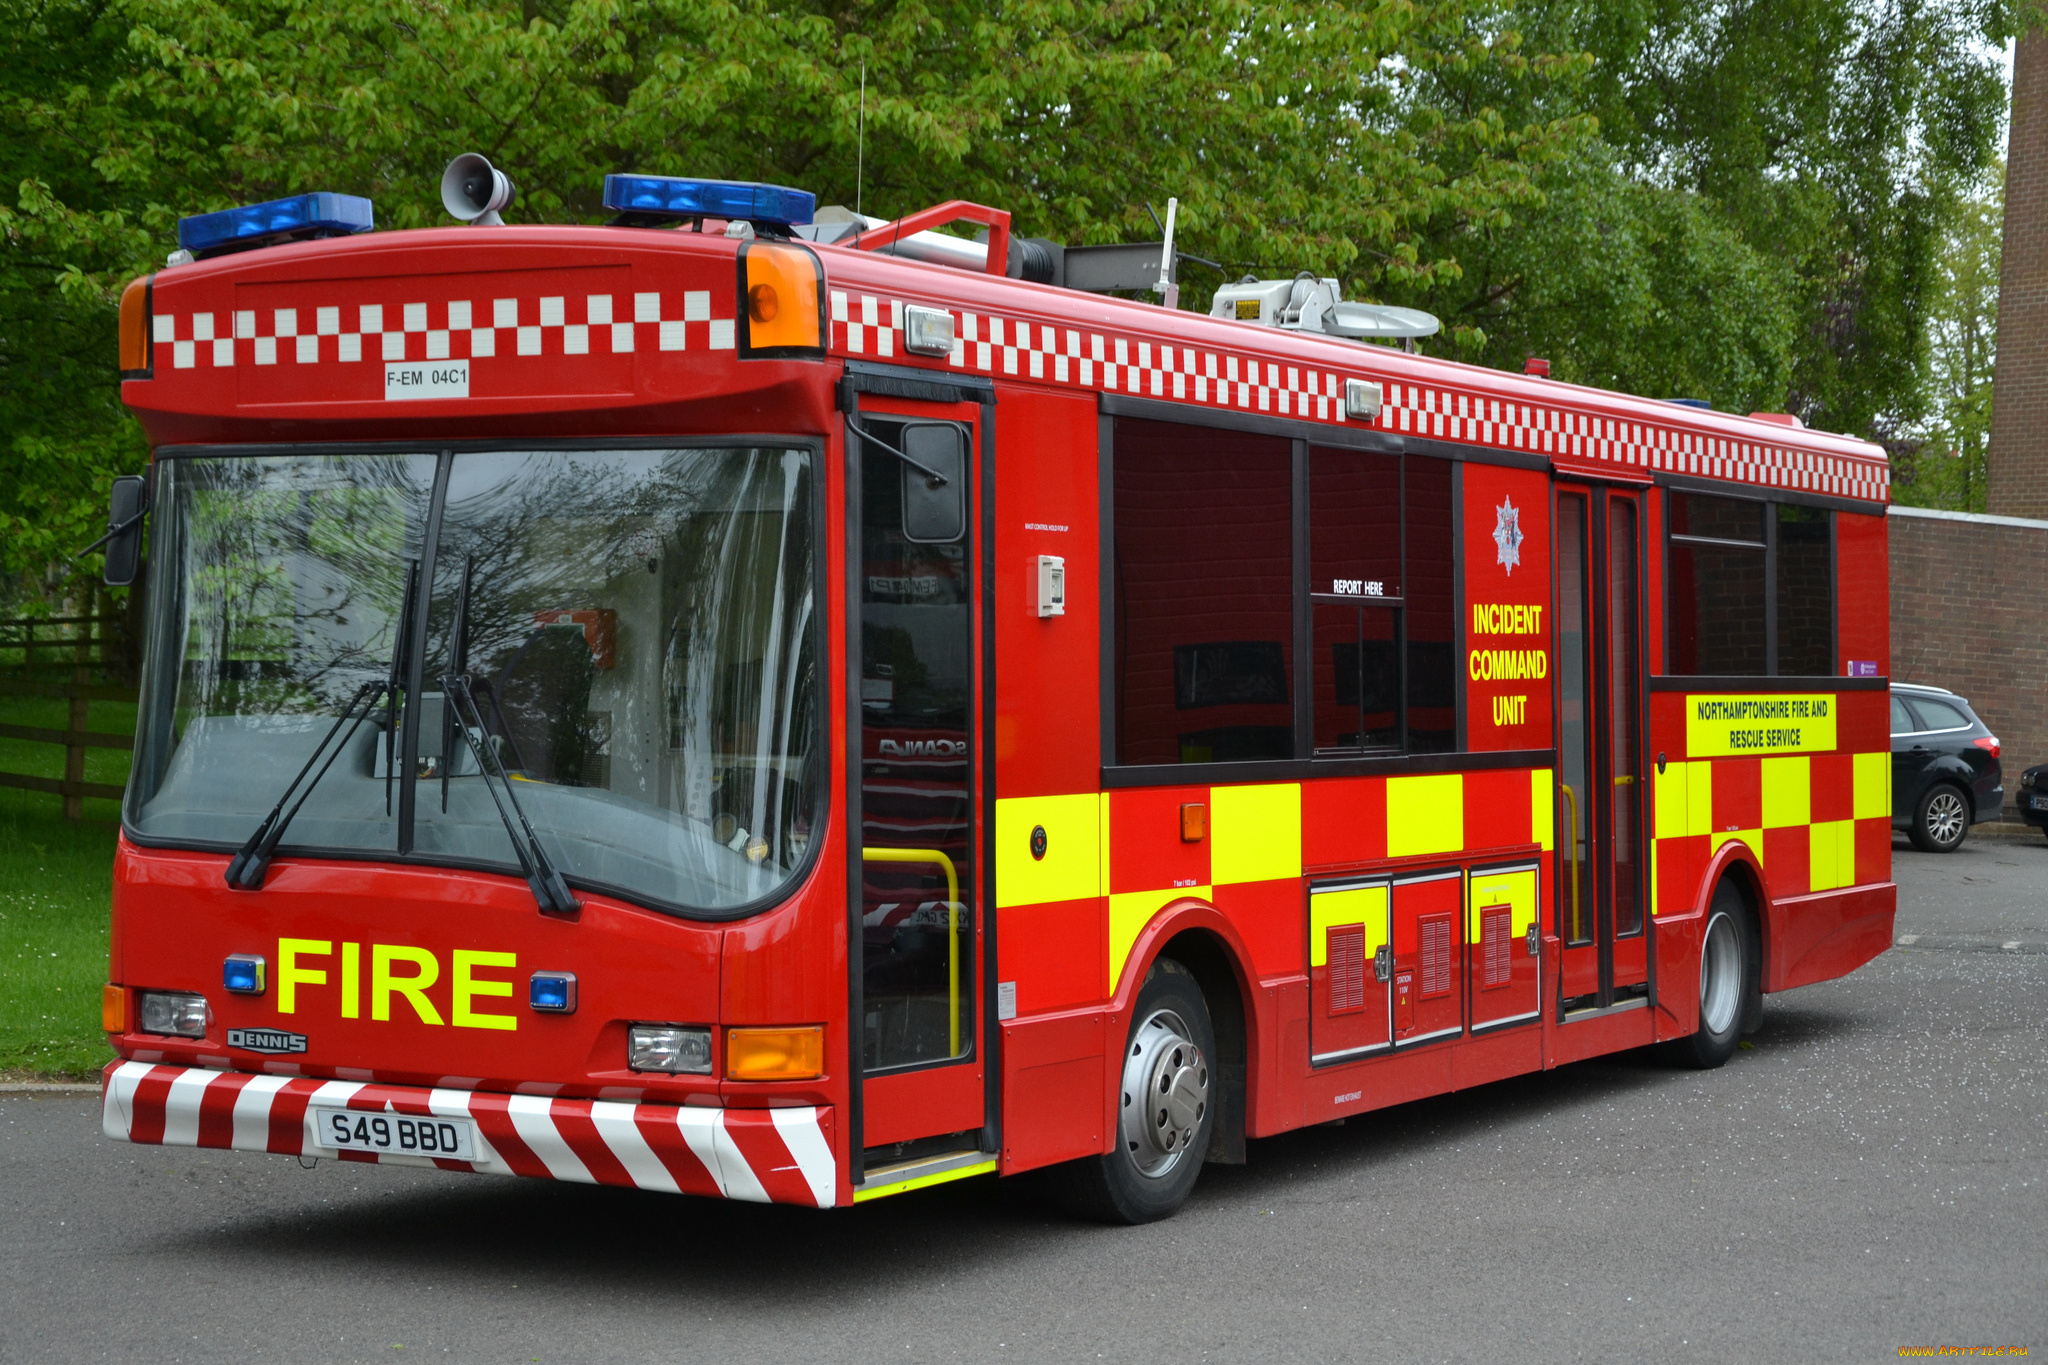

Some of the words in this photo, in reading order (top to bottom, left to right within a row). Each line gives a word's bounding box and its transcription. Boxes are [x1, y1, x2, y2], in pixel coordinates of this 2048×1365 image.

[387, 371, 422, 386] F-EM
[431, 368, 466, 384] 04C1
[1334, 579, 1362, 594] REPORT
[1364, 581, 1383, 595] HERE
[1473, 604, 1542, 634] INCIDENT
[1469, 649, 1547, 681] COMMAND
[1493, 695, 1527, 726] UNIT
[1698, 701, 1789, 720] NORTHAMPTONSHIRE
[1792, 701, 1809, 718] FIRE
[1811, 700, 1828, 717] AND
[1730, 730, 1764, 748] RESCUE
[1766, 728, 1801, 747] SERVICE
[278, 937, 517, 1031] FIRE
[1397, 975, 1411, 984] STATION
[1400, 986, 1408, 994] 110V
[227, 1030, 306, 1052] DENNIS
[332, 1114, 391, 1147] S49
[397, 1120, 458, 1153] BBD
